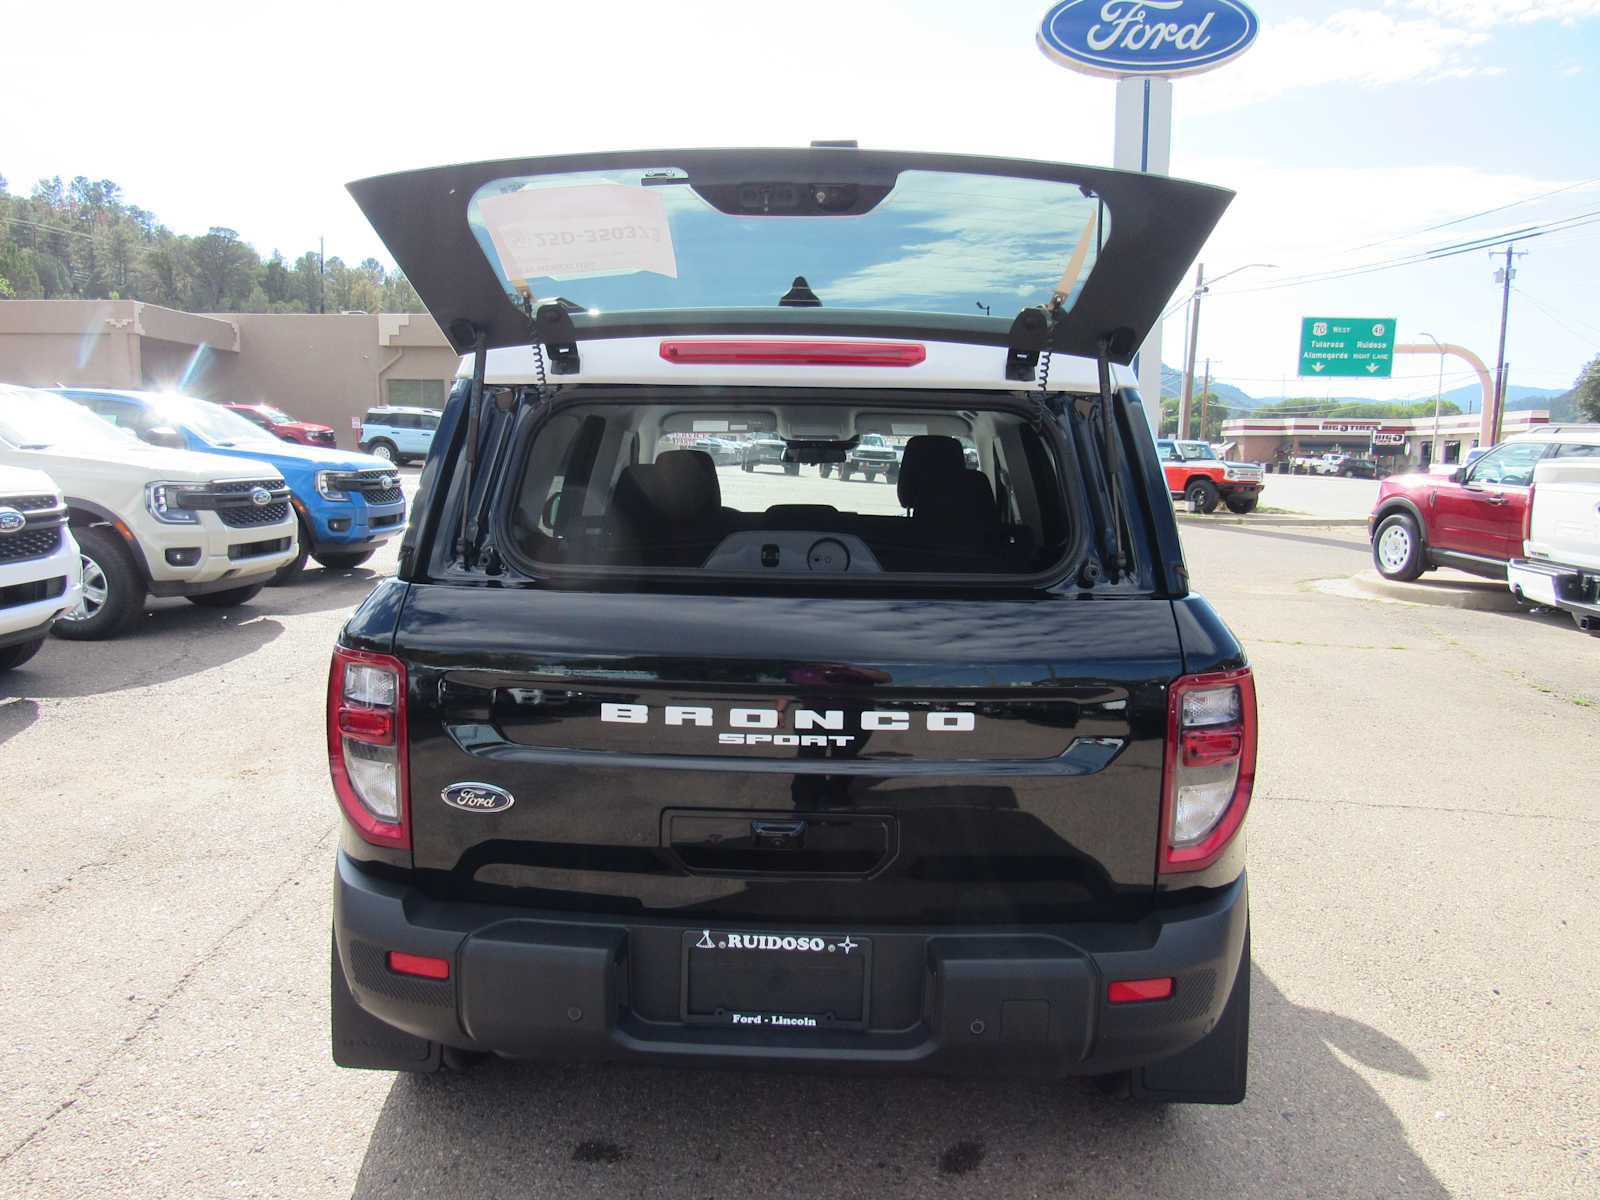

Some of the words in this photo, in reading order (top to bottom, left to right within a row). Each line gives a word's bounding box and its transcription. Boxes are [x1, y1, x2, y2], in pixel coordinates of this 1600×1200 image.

[1087, 0, 1216, 51] Ford
[1311, 340, 1345, 349] Tularosa
[1356, 341, 1387, 349] Ruidoso
[1303, 351, 1349, 360] Alamogordo
[601, 702, 975, 731] BRONCO
[719, 733, 855, 747] SPORT
[457, 788, 496, 807] Ford
[728, 935, 824, 951] RUIDOSO
[733, 1015, 762, 1024] Ford
[772, 1016, 816, 1026] Lincoln
